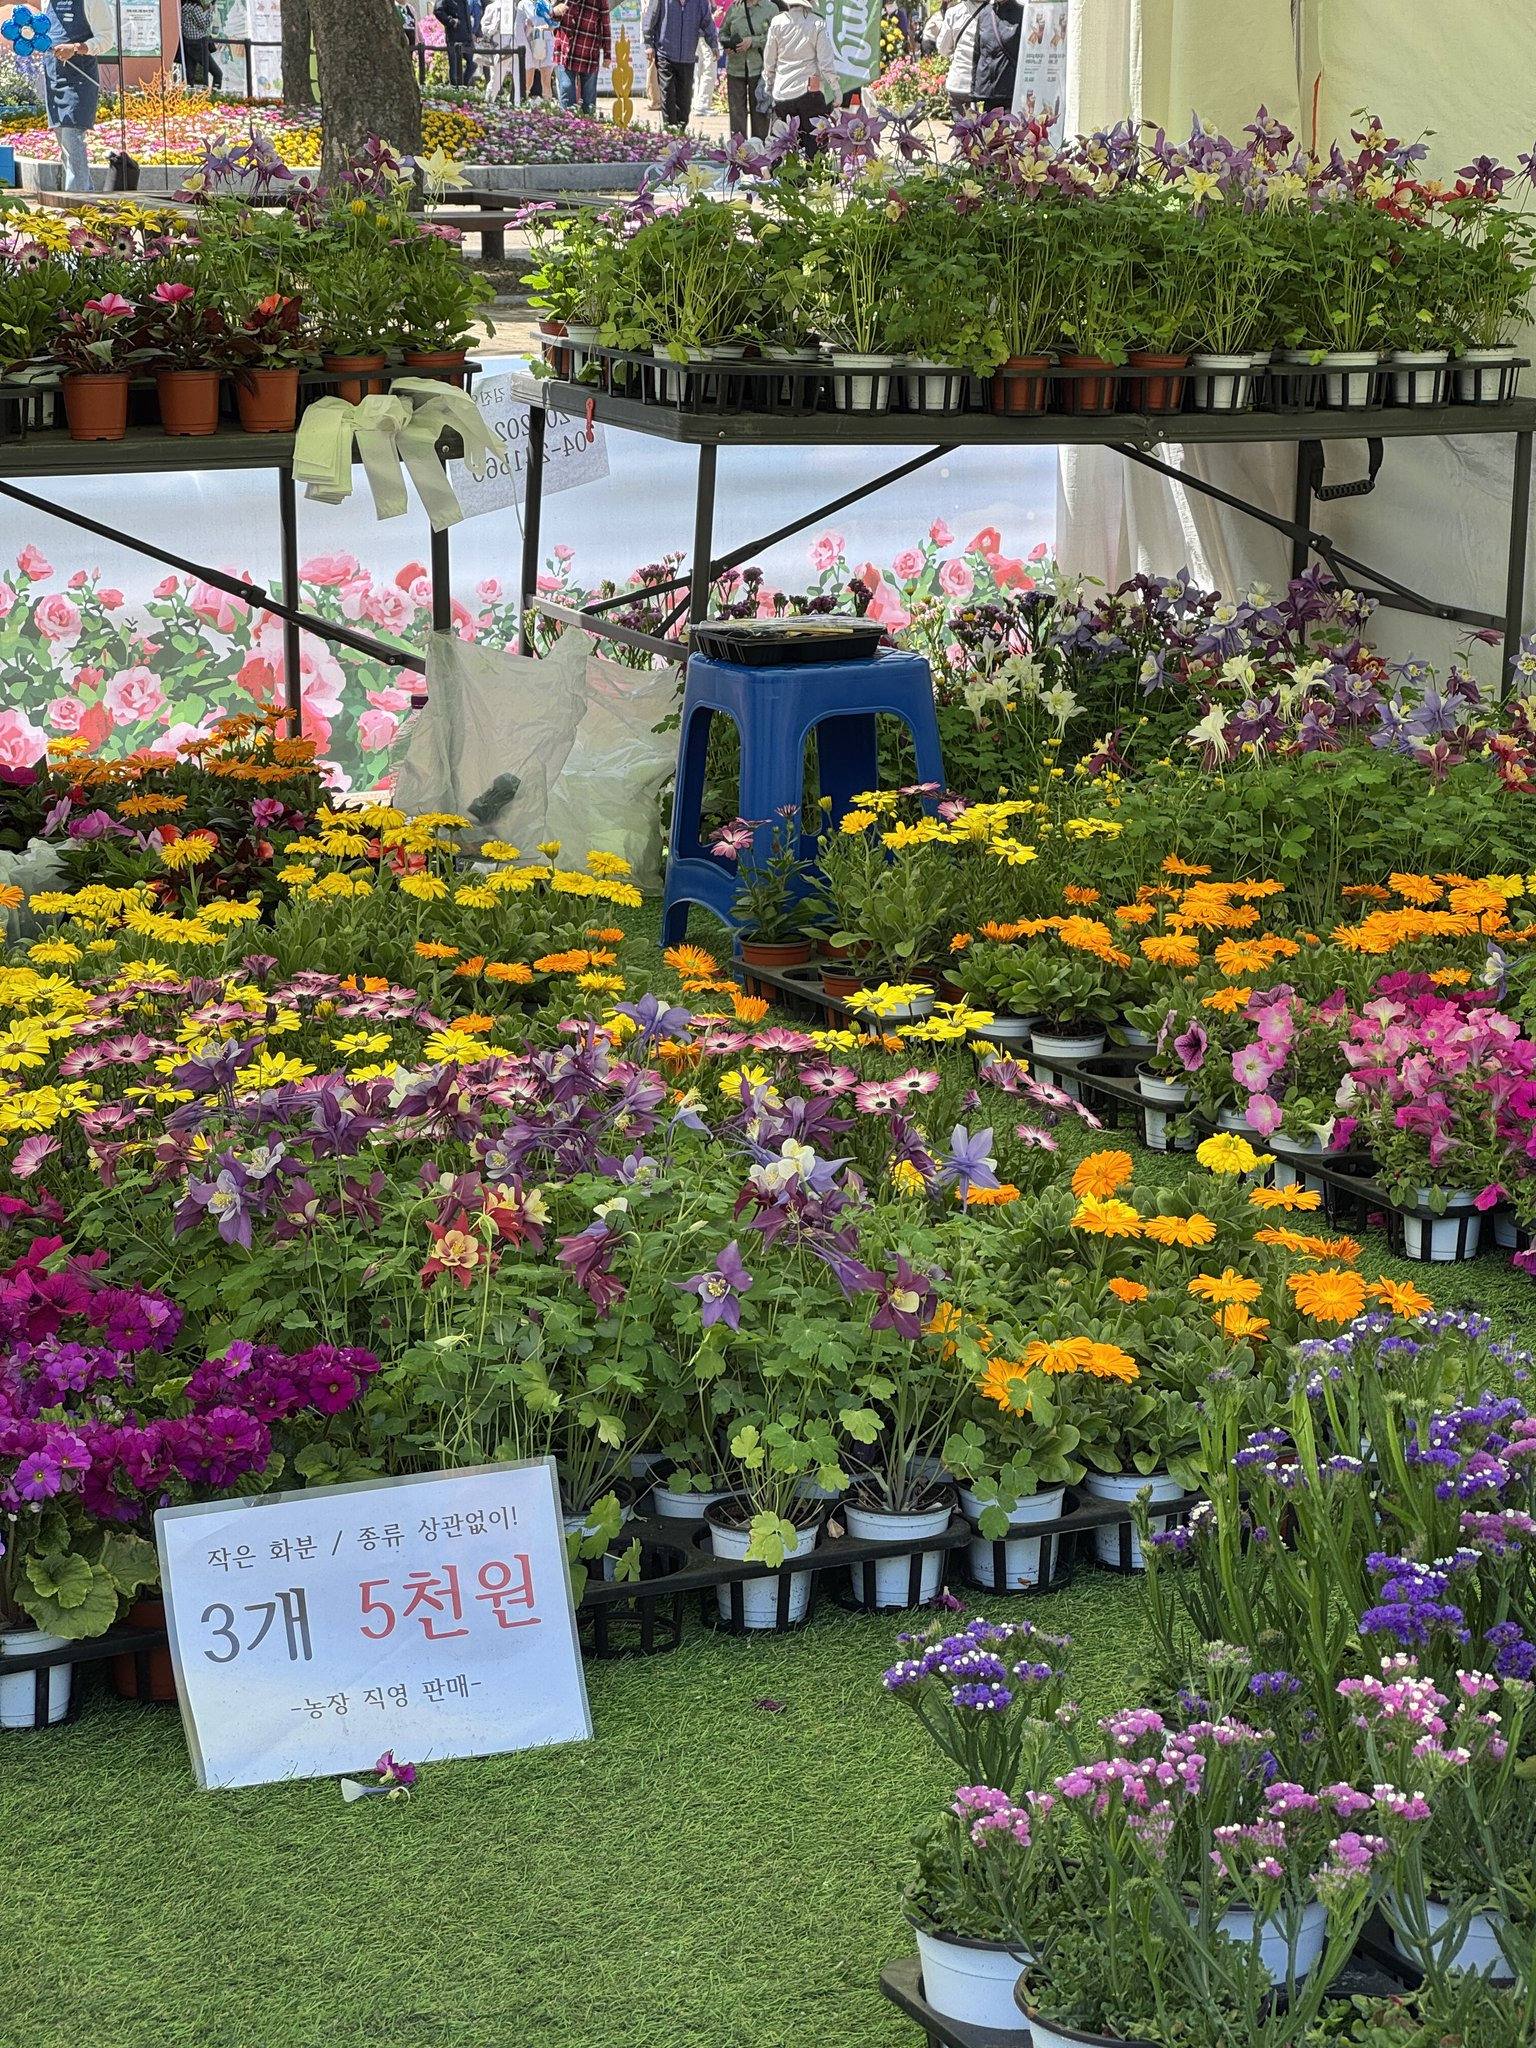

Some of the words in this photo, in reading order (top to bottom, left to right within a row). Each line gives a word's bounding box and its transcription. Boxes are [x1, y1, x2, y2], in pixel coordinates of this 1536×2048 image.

[207, 1545, 257, 1572] 작은
[269, 1535, 318, 1563] 화분
[331, 1530, 343, 1556] /
[357, 1523, 405, 1551] 종류
[418, 1505, 519, 1542] 상관없이!
[200, 1587, 313, 1663] 3개
[359, 1553, 542, 1640] 5천원
[290, 1692, 351, 1720] -농장
[363, 1683, 409, 1710] 직영
[421, 1673, 482, 1703] 판매-
